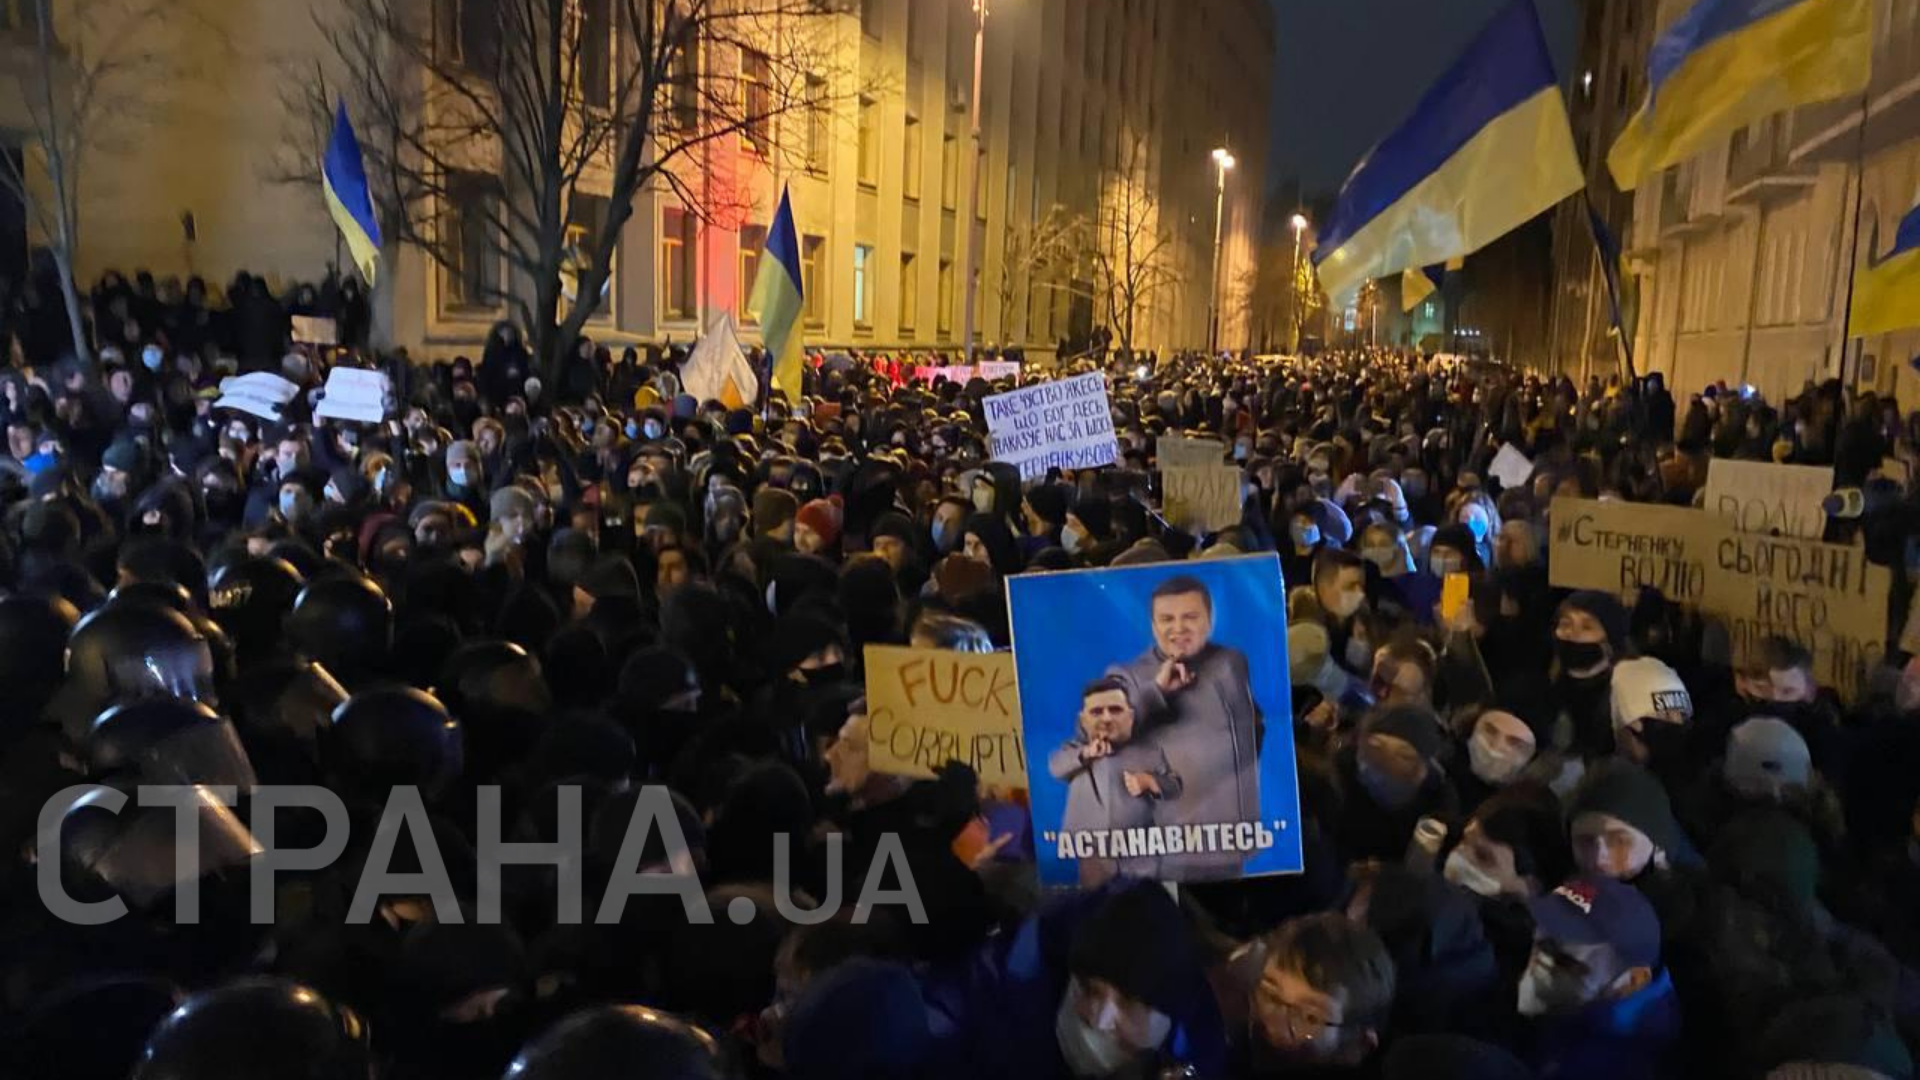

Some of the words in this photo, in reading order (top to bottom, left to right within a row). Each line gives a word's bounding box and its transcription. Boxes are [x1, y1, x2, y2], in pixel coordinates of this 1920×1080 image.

[986, 397, 1020, 421] ТАКЕ
[1065, 377, 1102, 400] ЯКЕСЬ
[1043, 404, 1069, 424] БОГ
[1073, 400, 1103, 418] ДЕСЬ
[1068, 420, 1082, 439] ЗА
[897, 658, 1015, 716] FUCK
[1044, 820, 1287, 859] "АСТАНАВИТЕСЬ"
